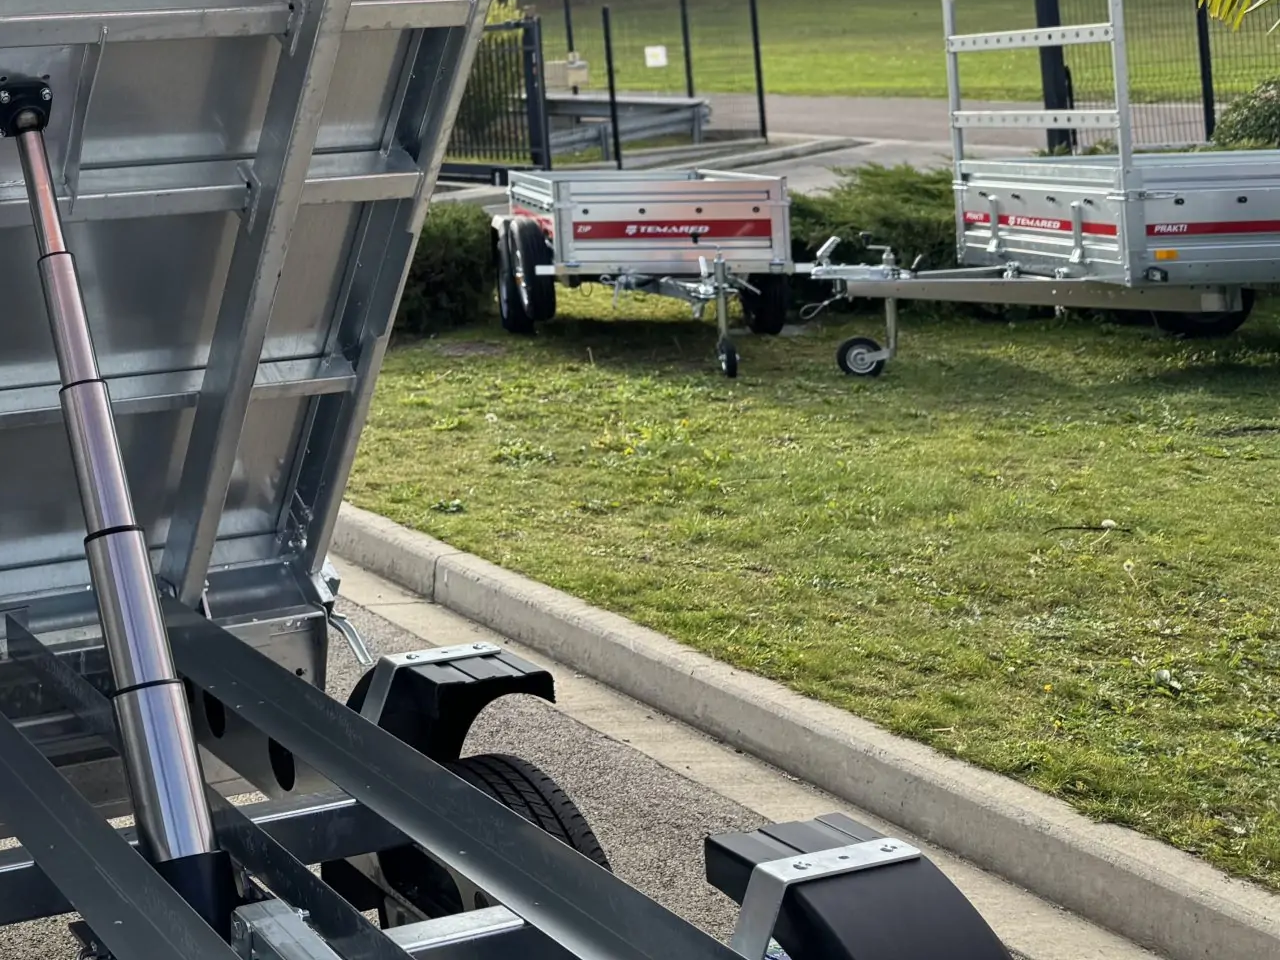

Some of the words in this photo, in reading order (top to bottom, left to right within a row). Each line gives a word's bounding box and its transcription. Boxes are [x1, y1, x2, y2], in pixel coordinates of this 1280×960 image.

[1016, 217, 1061, 229] TEMARED
[577, 225, 592, 233] ZIP
[640, 225, 710, 234] TEMARED
[1154, 224, 1188, 233] PRAKTI
